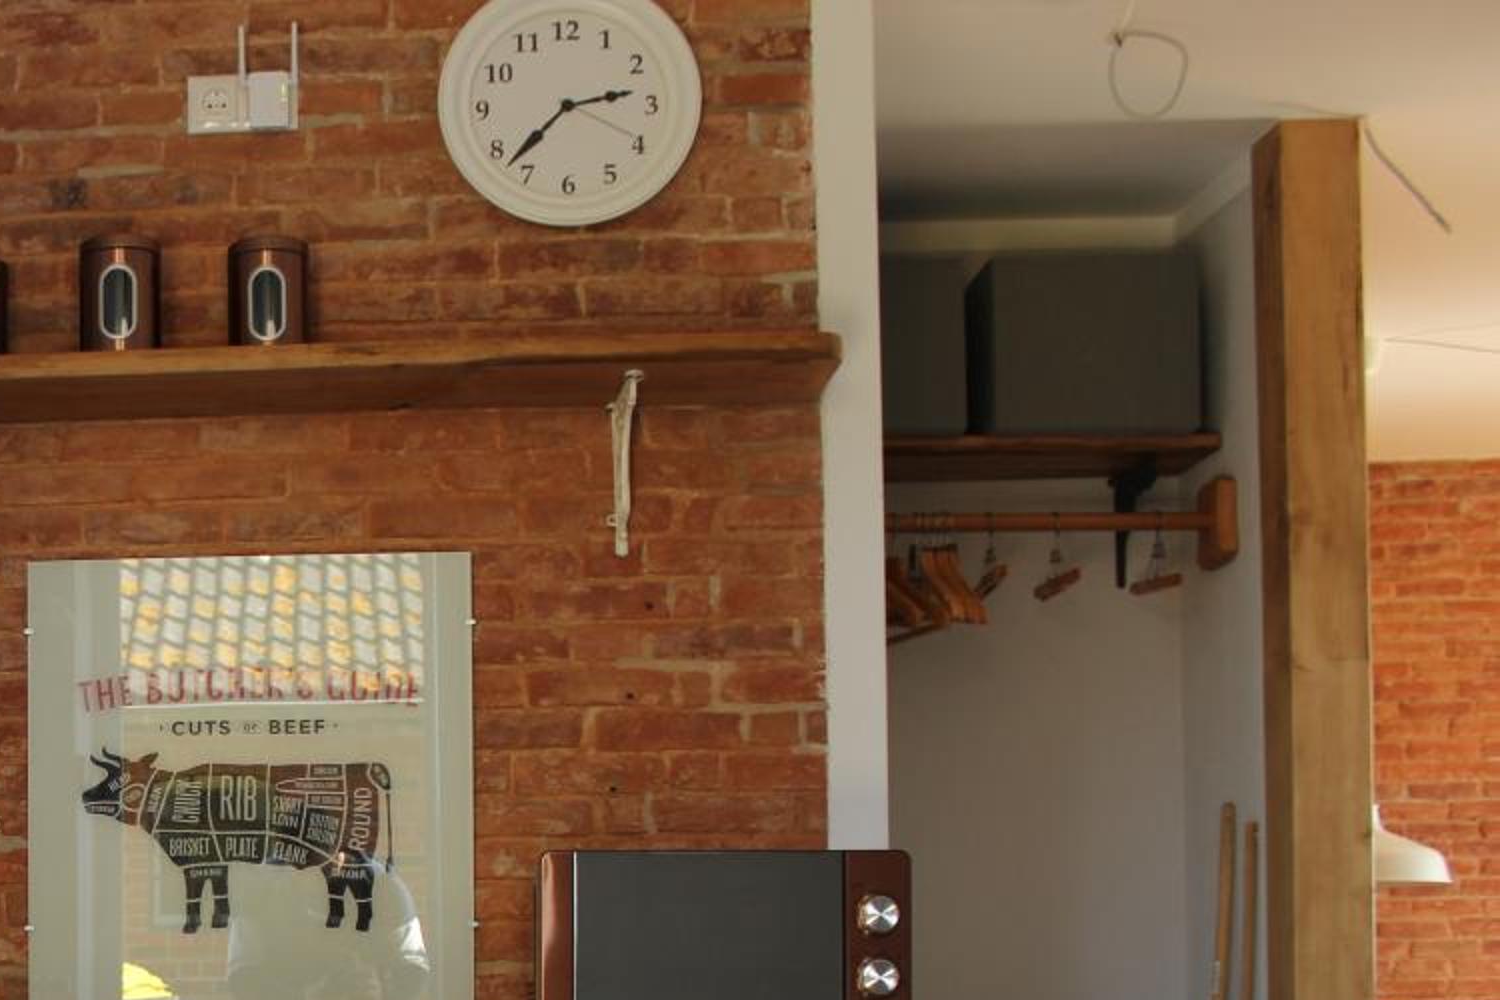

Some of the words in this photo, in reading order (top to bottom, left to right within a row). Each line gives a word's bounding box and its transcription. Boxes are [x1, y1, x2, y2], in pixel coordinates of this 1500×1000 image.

[552, 20, 580, 41] 12
[600, 30, 610, 49] 1
[514, 33, 538, 52] 11
[485, 63, 513, 84] 10
[629, 54, 644, 75] 2
[475, 101, 490, 120] 9
[645, 95, 659, 115] 3
[490, 140, 504, 160] 8
[631, 134, 644, 155] 4
[520, 165, 535, 185] 7
[603, 164, 617, 184] 5
[562, 176, 575, 195] 6
[77, 675, 133, 712] THE
[171, 720, 231, 736] CUTS
[269, 719, 325, 735] BEEF
[220, 775, 257, 822] RIB
[349, 787, 373, 851] ROUND
[225, 837, 258, 858] PLATE
